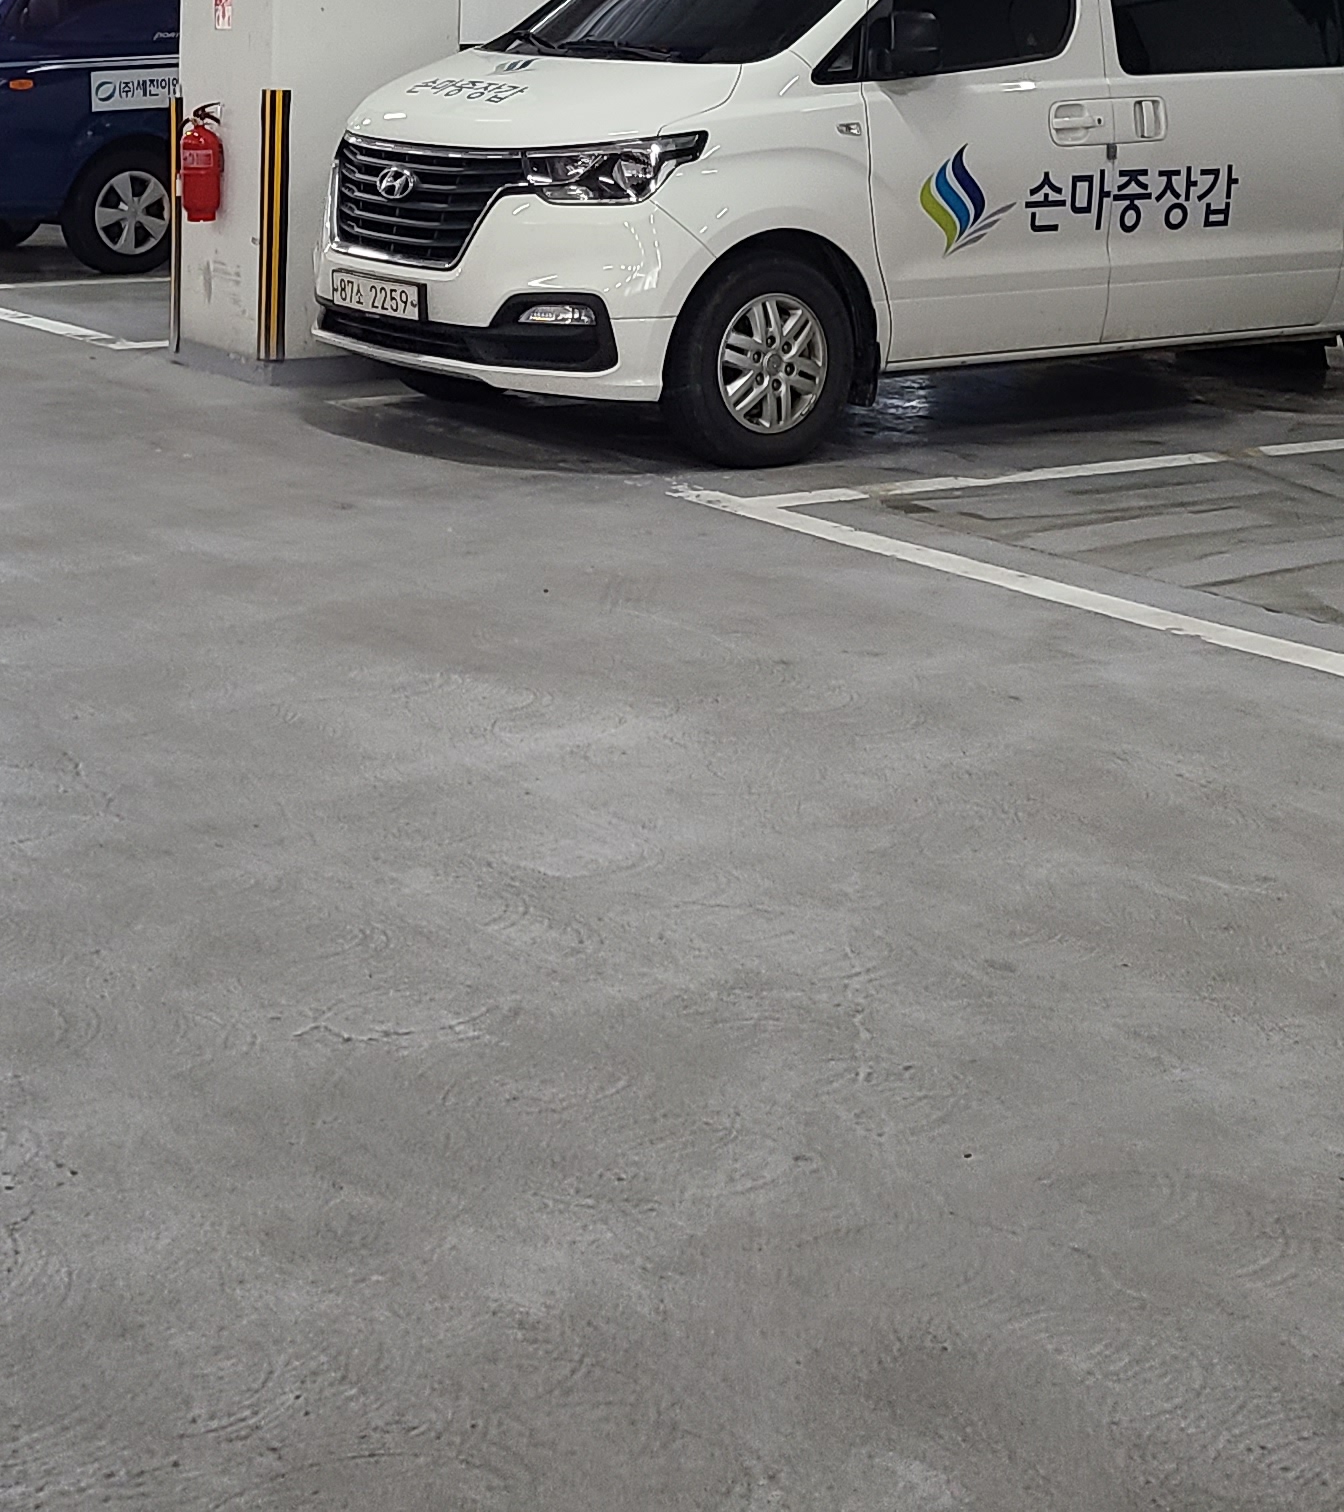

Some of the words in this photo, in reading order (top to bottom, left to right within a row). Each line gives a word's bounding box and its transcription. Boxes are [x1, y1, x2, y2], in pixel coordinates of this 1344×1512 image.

[1025, 163, 1239, 233] 손마중장갑
[339, 277, 364, 306] 87소
[369, 284, 409, 314] 2259
